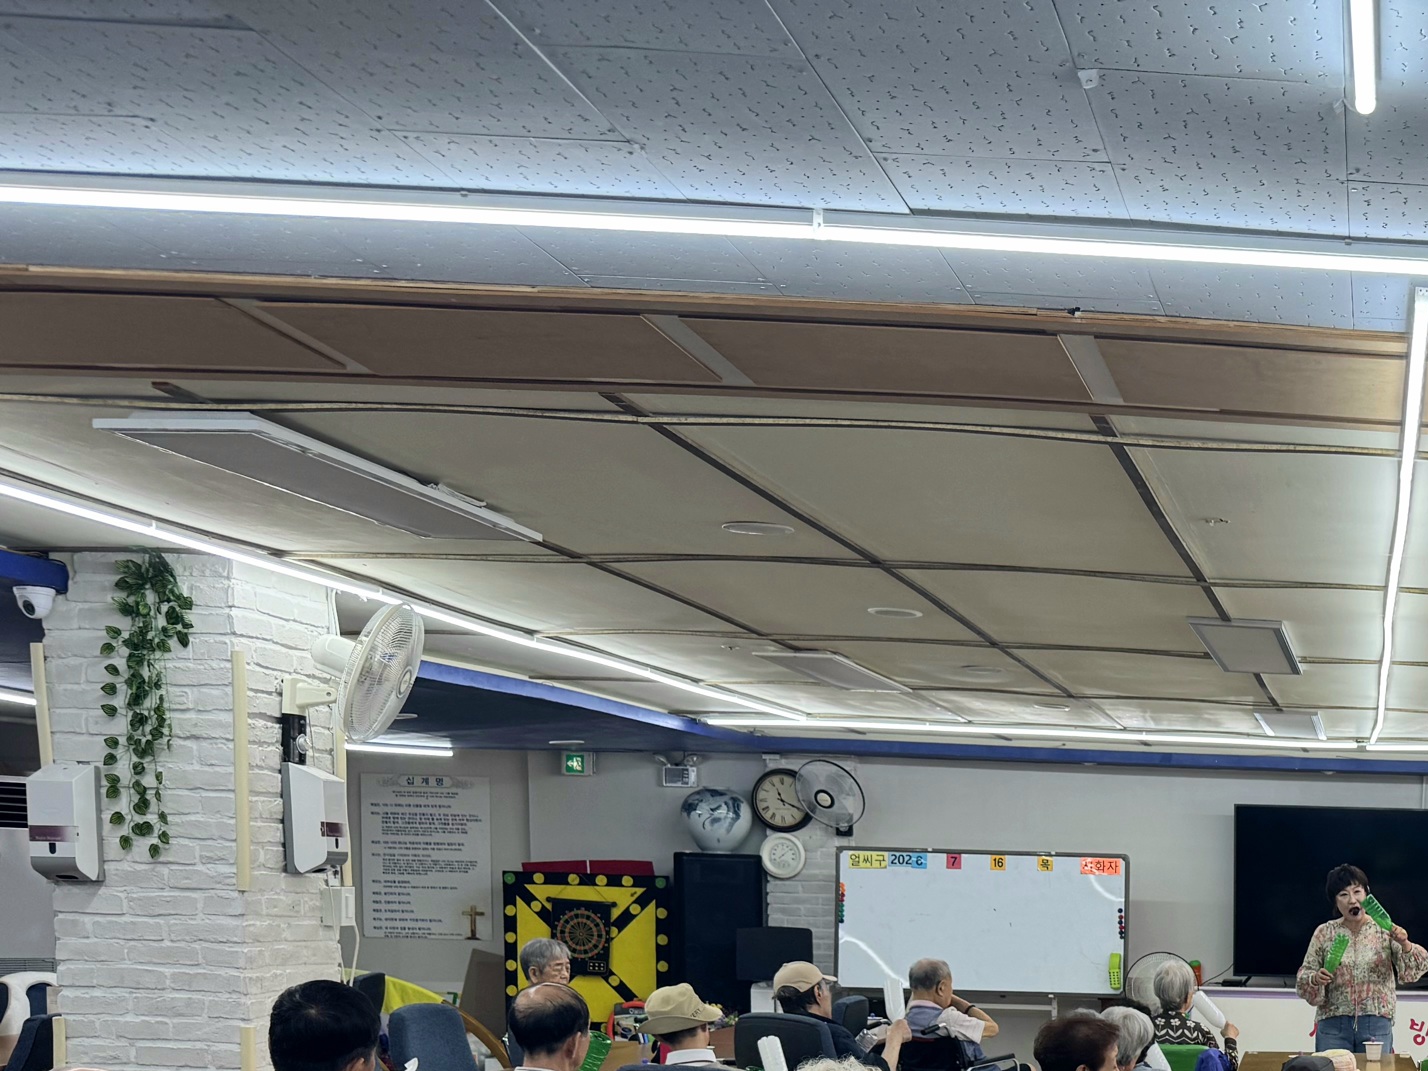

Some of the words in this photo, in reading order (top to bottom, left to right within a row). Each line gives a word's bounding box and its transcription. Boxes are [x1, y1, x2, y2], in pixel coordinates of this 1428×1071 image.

[849, 853, 887, 867] 얼씨구
[950, 857, 957, 867] 7
[992, 858, 1004, 868] 16
[1039, 858, 1051, 871] 목
